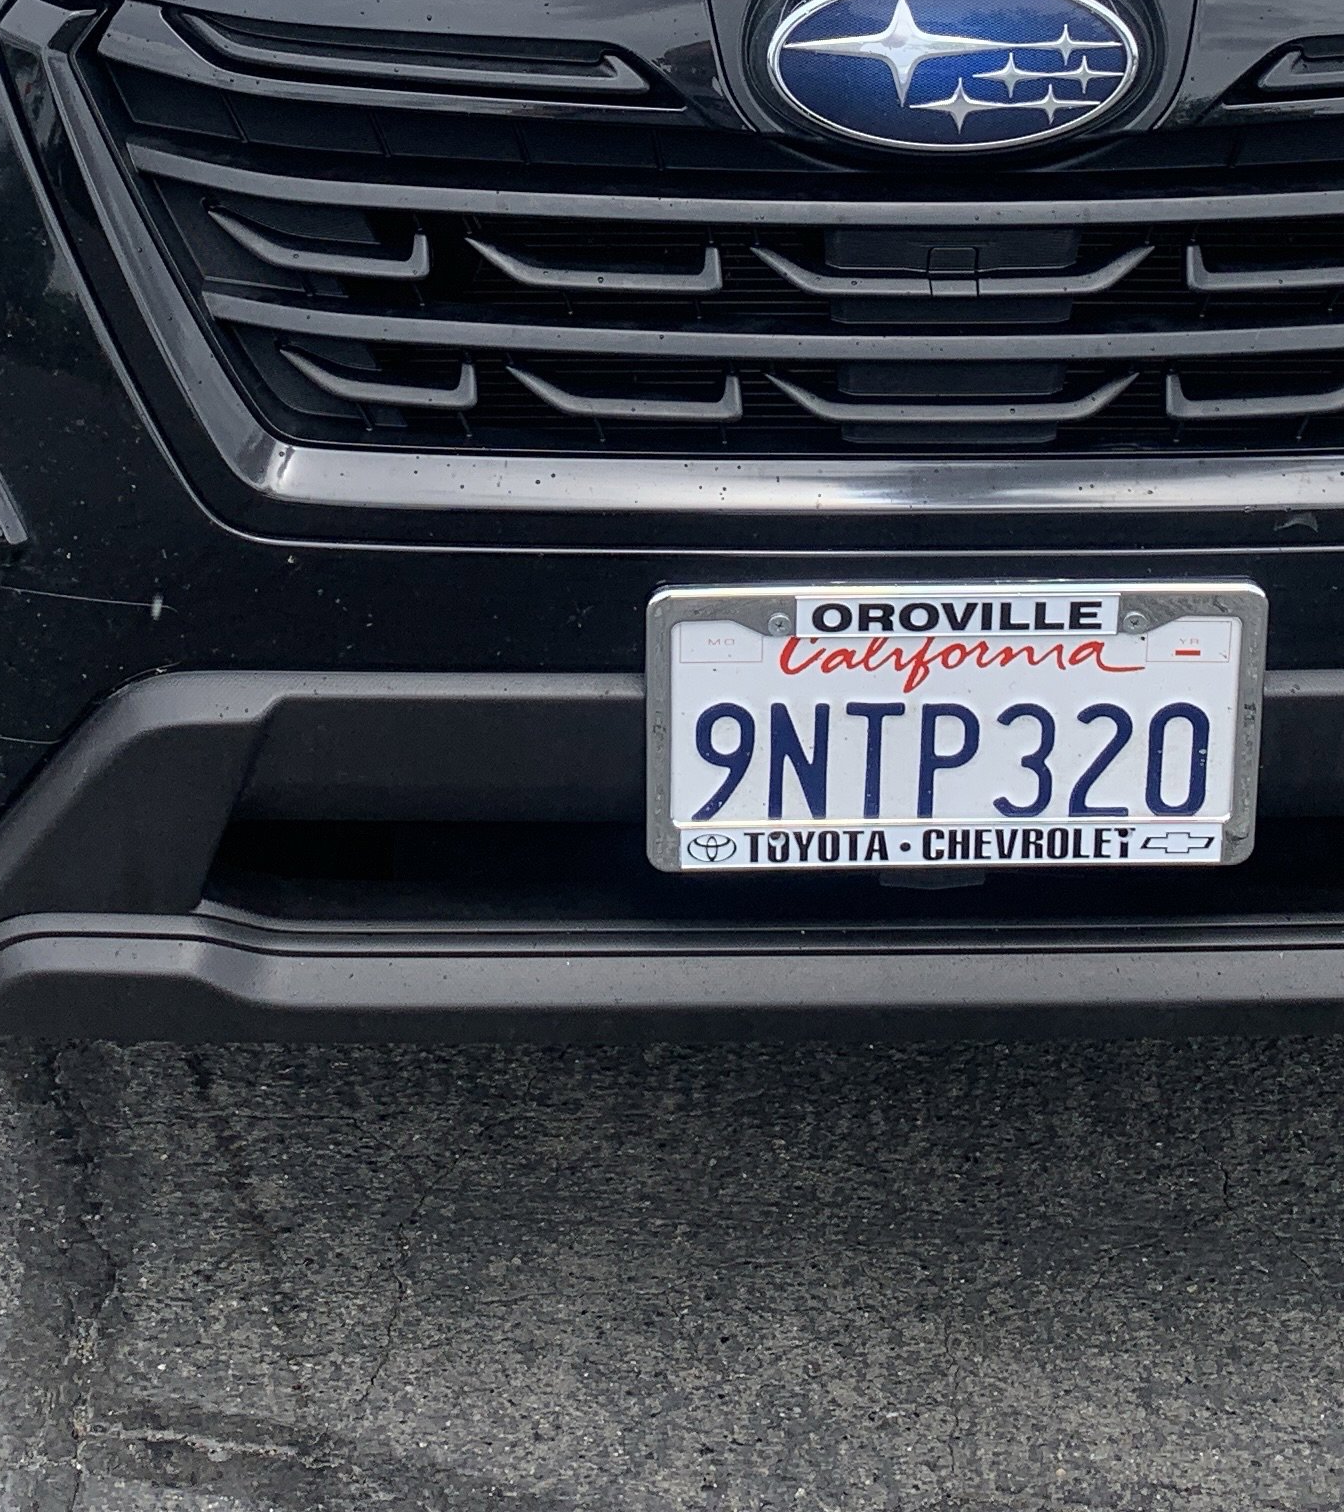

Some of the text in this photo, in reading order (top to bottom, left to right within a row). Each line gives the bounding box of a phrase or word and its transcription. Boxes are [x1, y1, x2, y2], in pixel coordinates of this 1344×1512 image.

[812, 601, 1102, 632] OROVILLE
[708, 638, 735, 646] MO
[1179, 637, 1200, 645] YR
[780, 636, 1145, 694] California
[691, 701, 1210, 822] 9NTP320
[743, 827, 1136, 863] TOYOTA CHEVROLET
